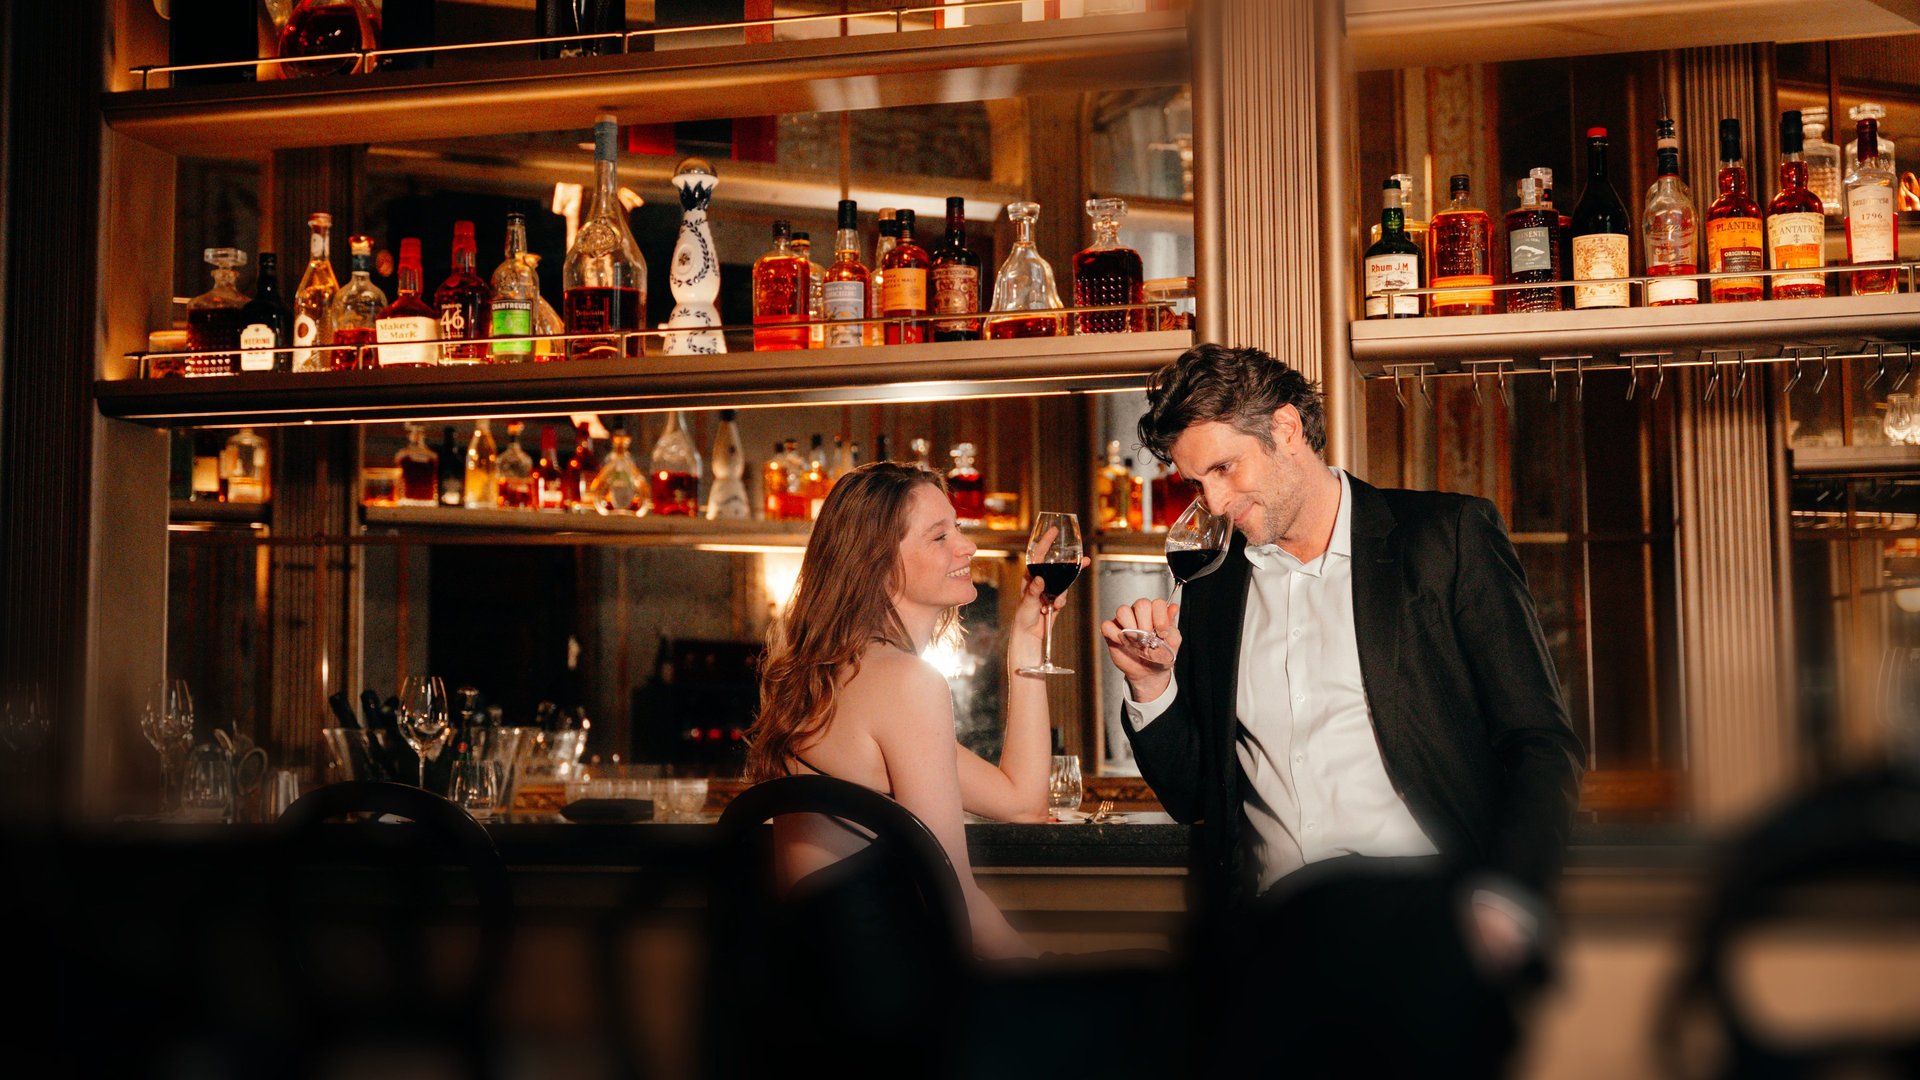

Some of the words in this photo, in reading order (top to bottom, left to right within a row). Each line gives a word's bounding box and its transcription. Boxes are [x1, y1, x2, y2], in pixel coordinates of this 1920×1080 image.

[1861, 212, 1883, 221] 1796
[1371, 263, 1393, 272] Rhum
[440, 309, 465, 333] 46
[380, 322, 418, 331] Maker's
[390, 330, 417, 339] Mark
